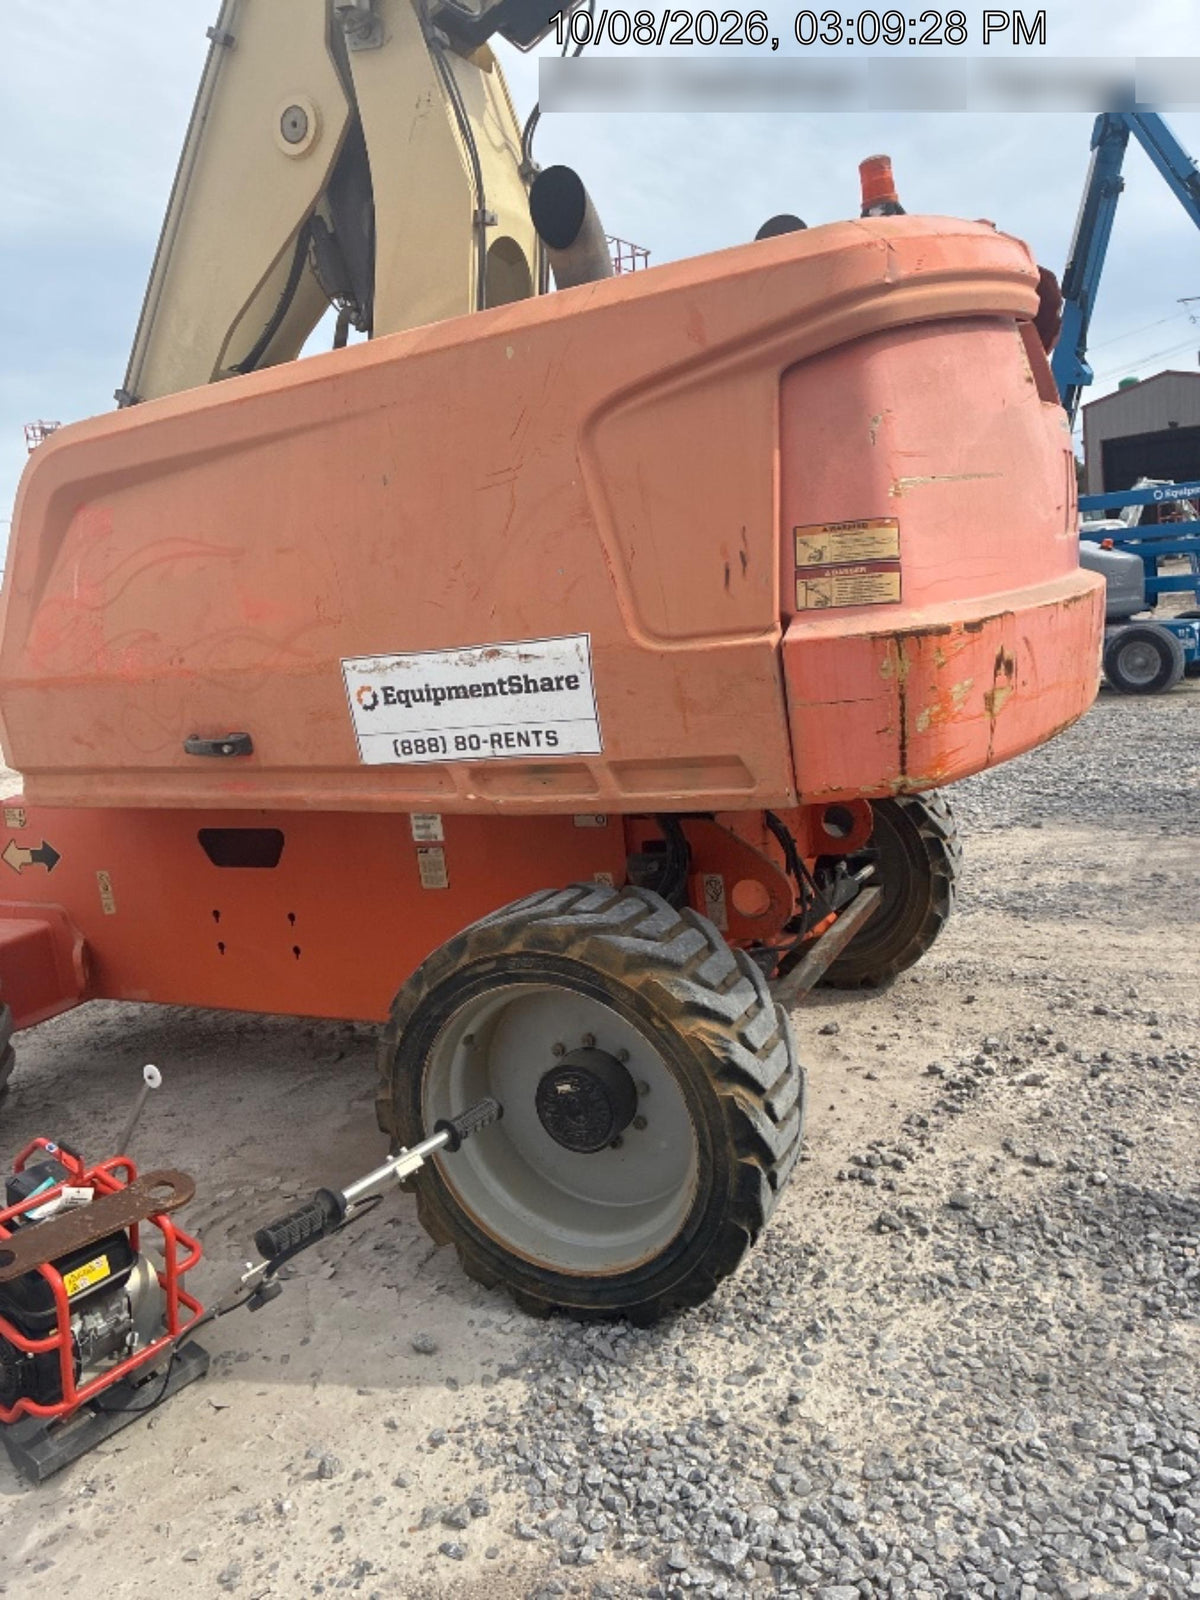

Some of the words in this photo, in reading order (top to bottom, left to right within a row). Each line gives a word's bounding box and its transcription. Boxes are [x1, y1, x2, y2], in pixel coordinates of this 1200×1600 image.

[380, 673, 580, 708] EquipmentShare
[393, 735, 447, 757] (888)
[454, 729, 559, 751] 80-RENTS
